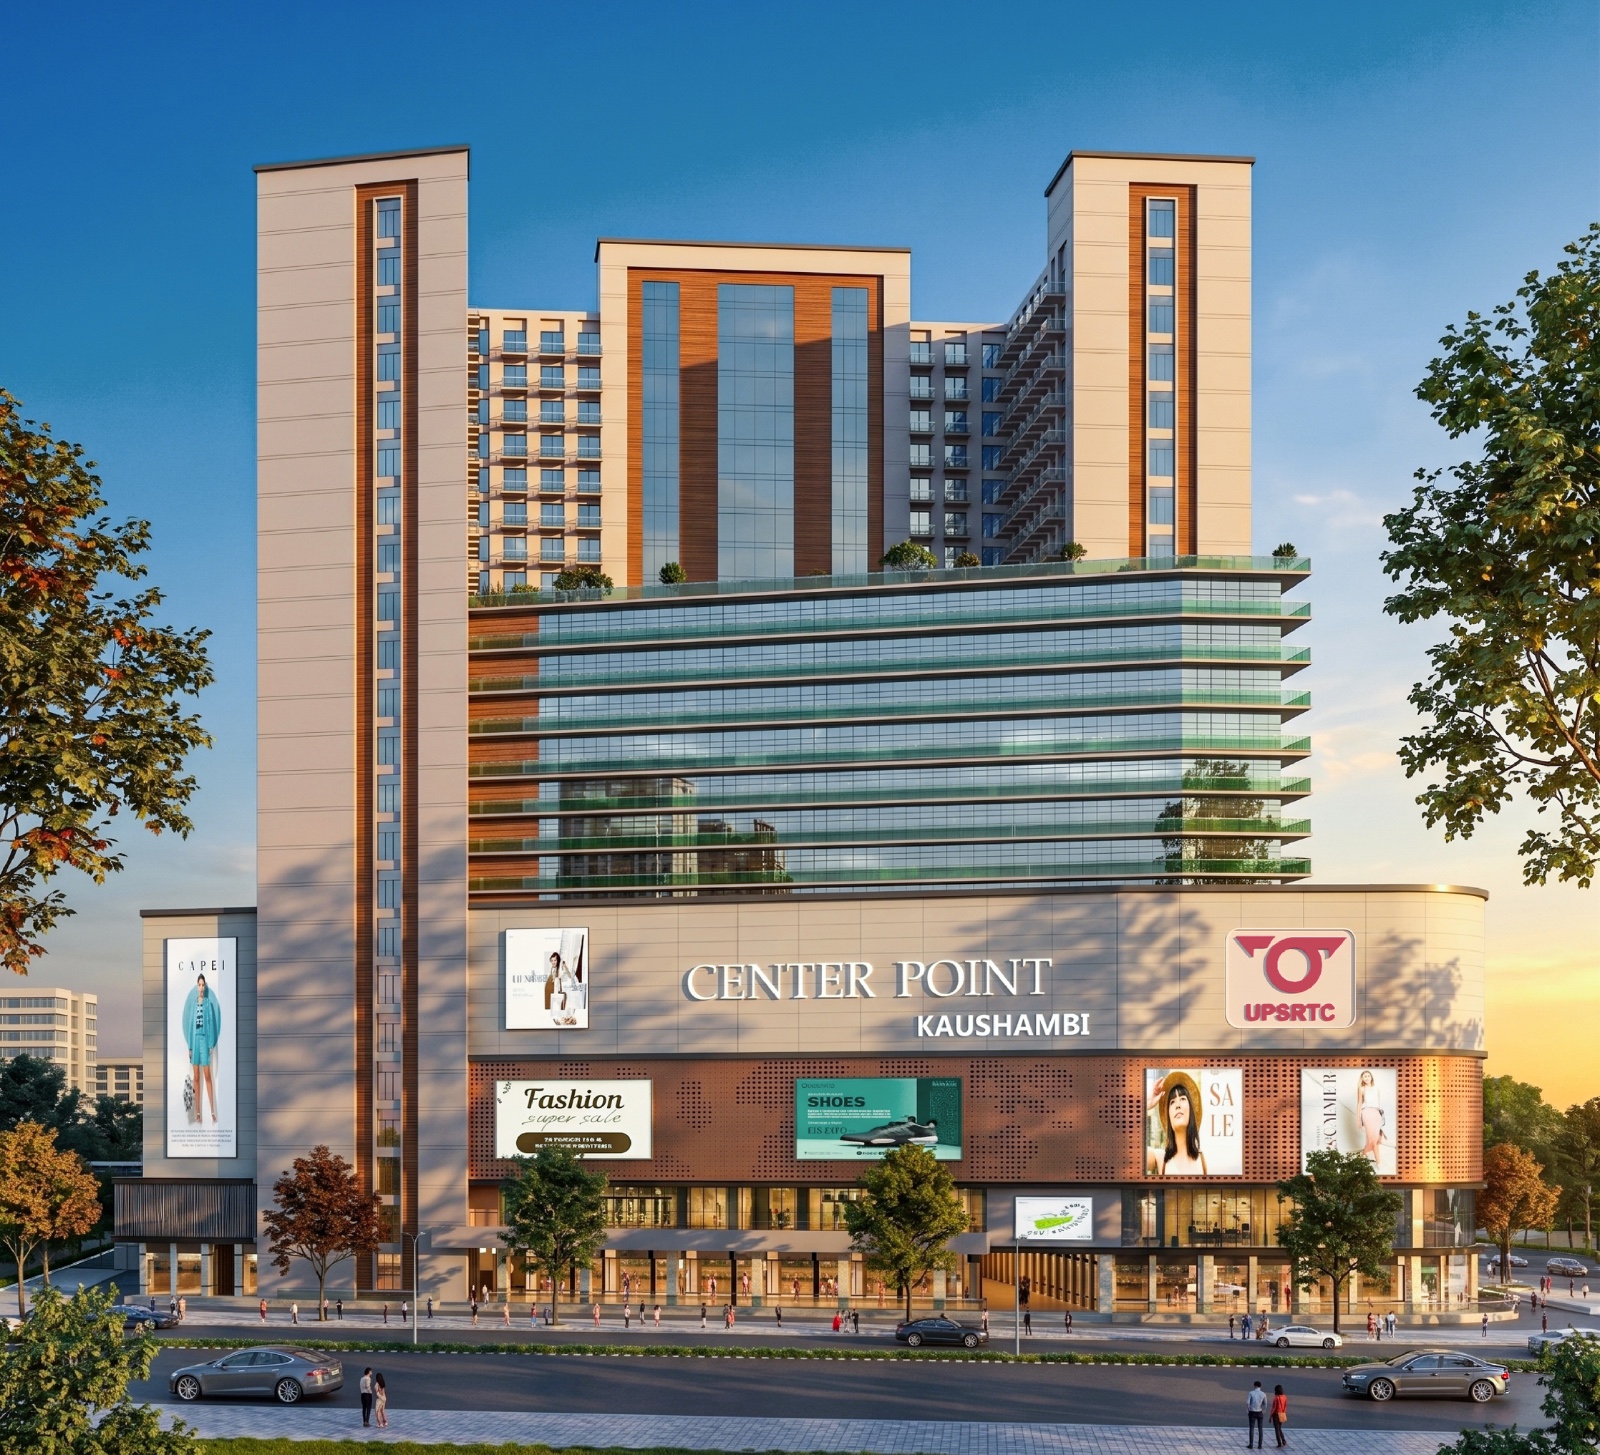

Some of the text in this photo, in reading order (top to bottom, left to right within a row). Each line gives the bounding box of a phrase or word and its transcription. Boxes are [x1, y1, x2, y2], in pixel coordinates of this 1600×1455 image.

[685, 957, 1053, 1001] CENTER POINT
[1244, 1003, 1336, 1022] UPSRTC
[916, 1012, 1091, 1037] KAUSHAMBI
[524, 1087, 625, 1110] Fashion
[807, 1096, 866, 1107] SHOES
[521, 1109, 622, 1132] super sale
